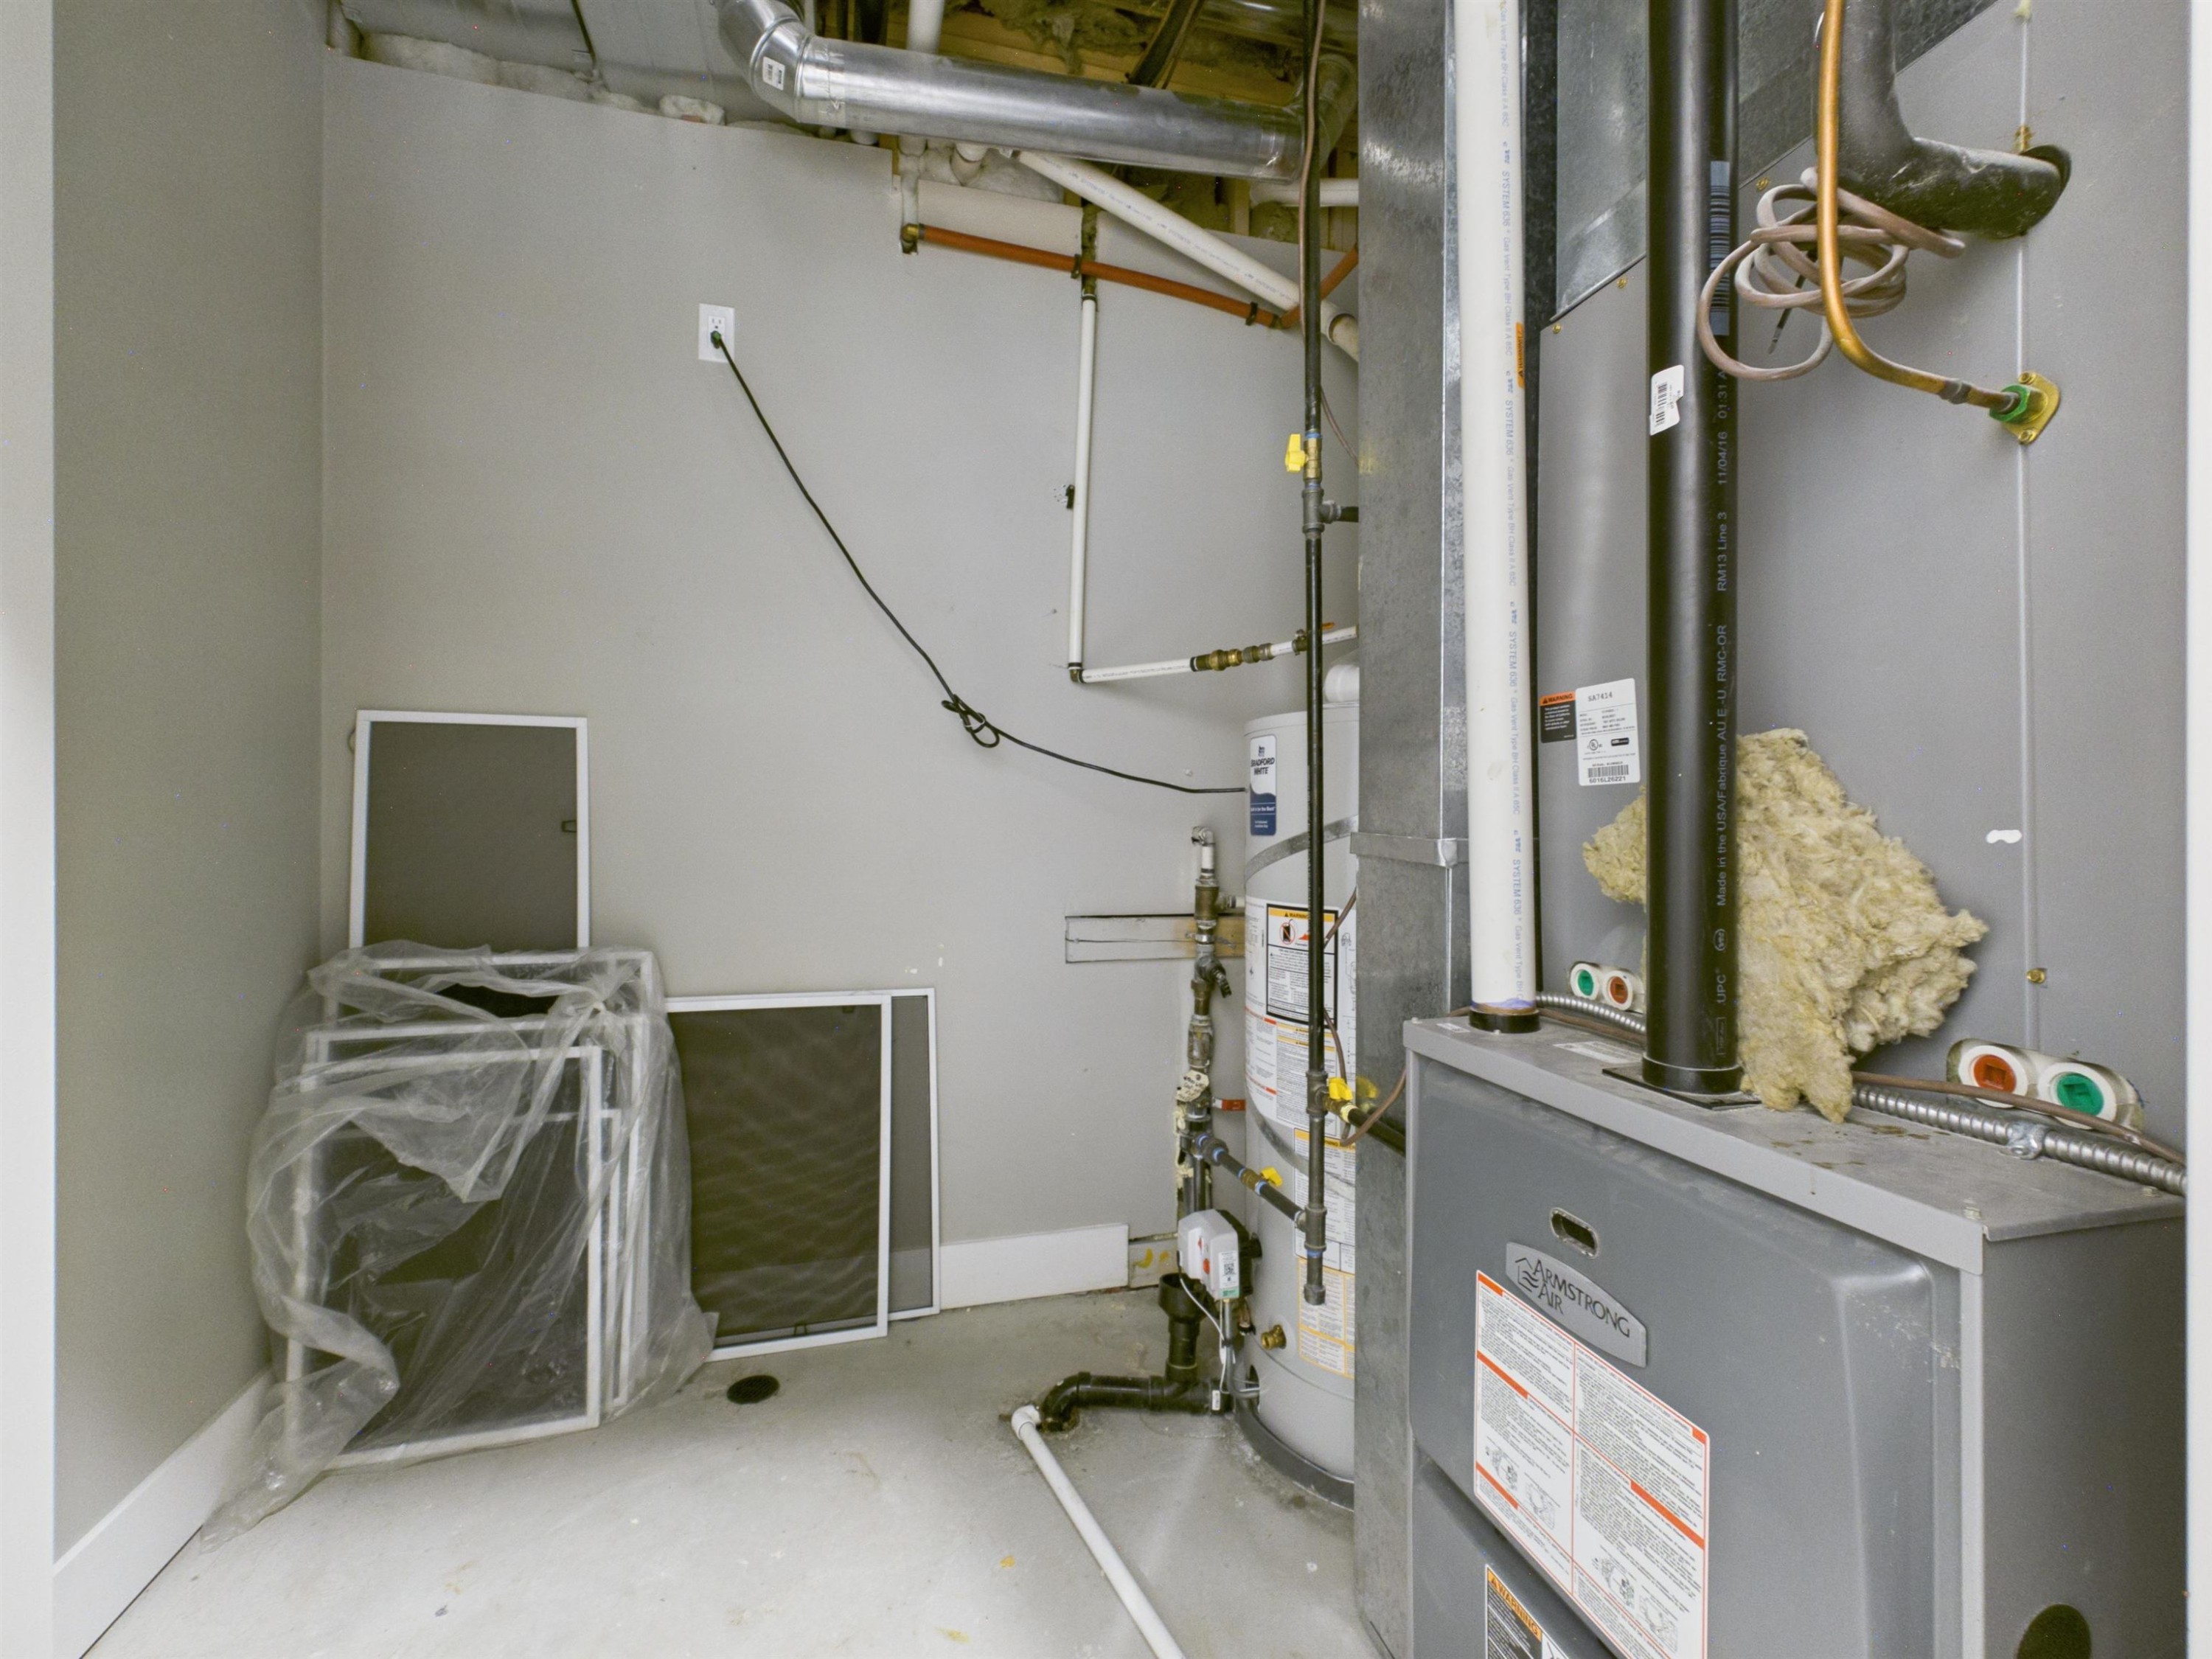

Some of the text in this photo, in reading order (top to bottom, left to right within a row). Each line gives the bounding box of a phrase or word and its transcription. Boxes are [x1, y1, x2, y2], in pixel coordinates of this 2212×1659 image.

[1501, 171, 1510, 209] SYSTEM
[1718, 383, 1727, 418] 01:31
[1504, 400, 1513, 438] SYSTEM
[1718, 431, 1727, 485] 11/04/16
[1506, 503, 1514, 521] Type
[1718, 511, 1727, 519] 3
[1718, 524, 1727, 549] Line
[1718, 554, 1727, 591] RM13
[1509, 631, 1517, 669] SYSTEM
[1718, 624, 1727, 681] RMC-OR
[1510, 698, 1518, 712] Gas
[1548, 693, 1573, 703] WARNING
[1510, 734, 1518, 751] Type
[1718, 721, 1727, 740] AU
[1251, 757, 1275, 767] BRADFORD
[1253, 767, 1269, 776] WHITE
[1717, 744, 1728, 831] USA/Fabrique
[1718, 834, 1727, 853] the
[1718, 857, 1727, 867] in
[1512, 859, 1520, 897] SYSTEM
[1718, 872, 1727, 905] Made
[1513, 900, 1521, 916] 636
[1514, 961, 1523, 979] Type
[1533, 1259, 1630, 1338] ARMSTRONG
[1538, 1283, 1564, 1315] AIR
[1498, 1583, 1538, 1636] WARNING
